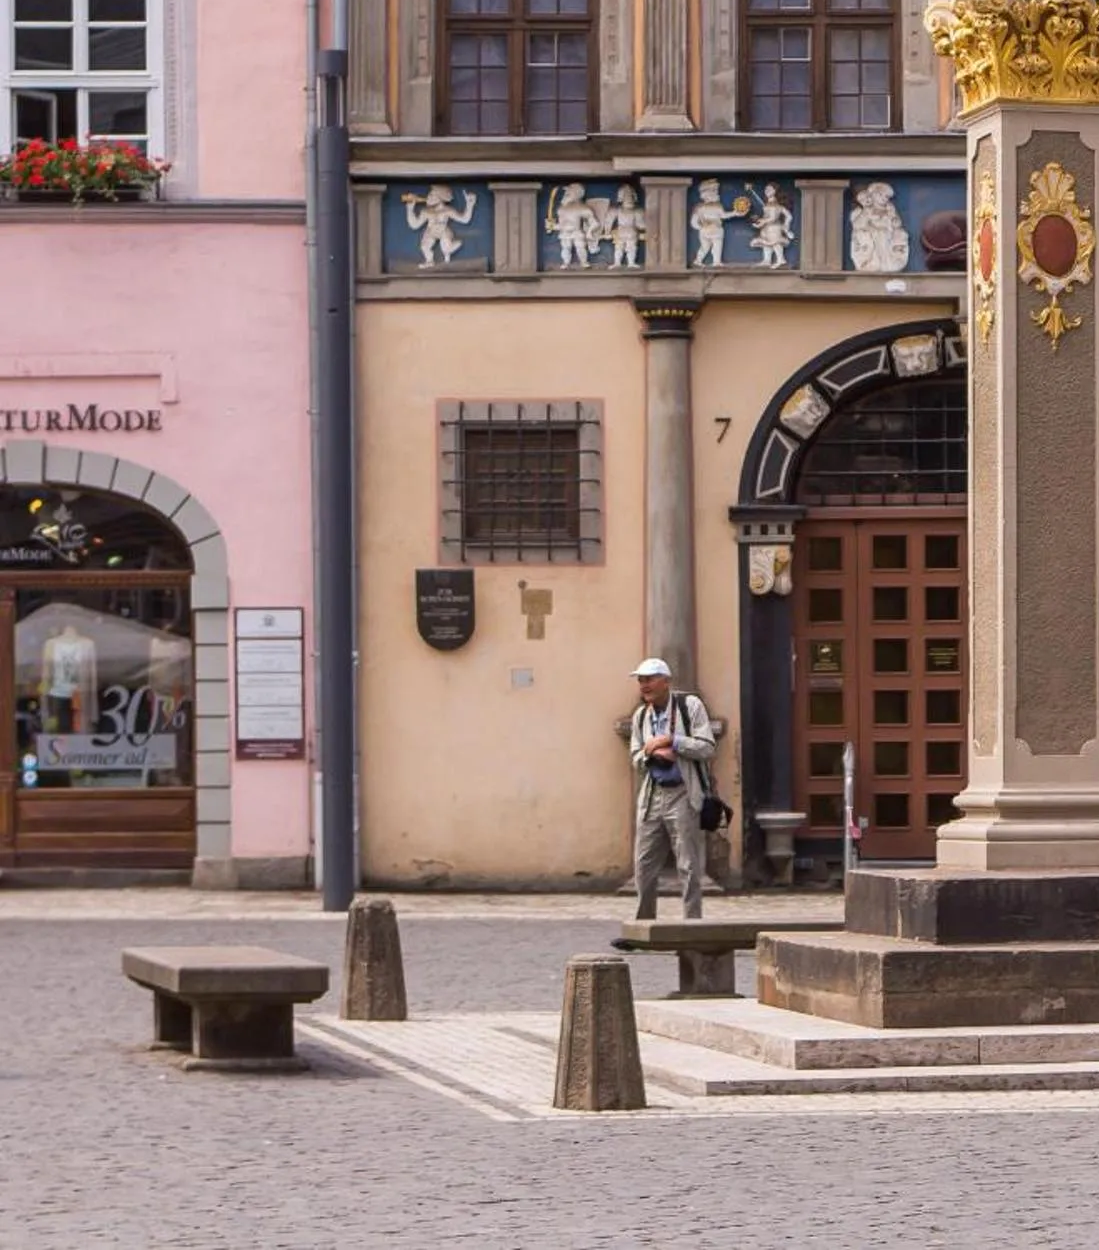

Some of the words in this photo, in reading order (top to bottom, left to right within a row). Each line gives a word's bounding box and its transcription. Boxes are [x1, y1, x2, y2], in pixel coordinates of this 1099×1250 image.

[0, 404, 163, 432] TURMODE
[714, 417, 732, 444] 7
[91, 684, 187, 747] 30%
